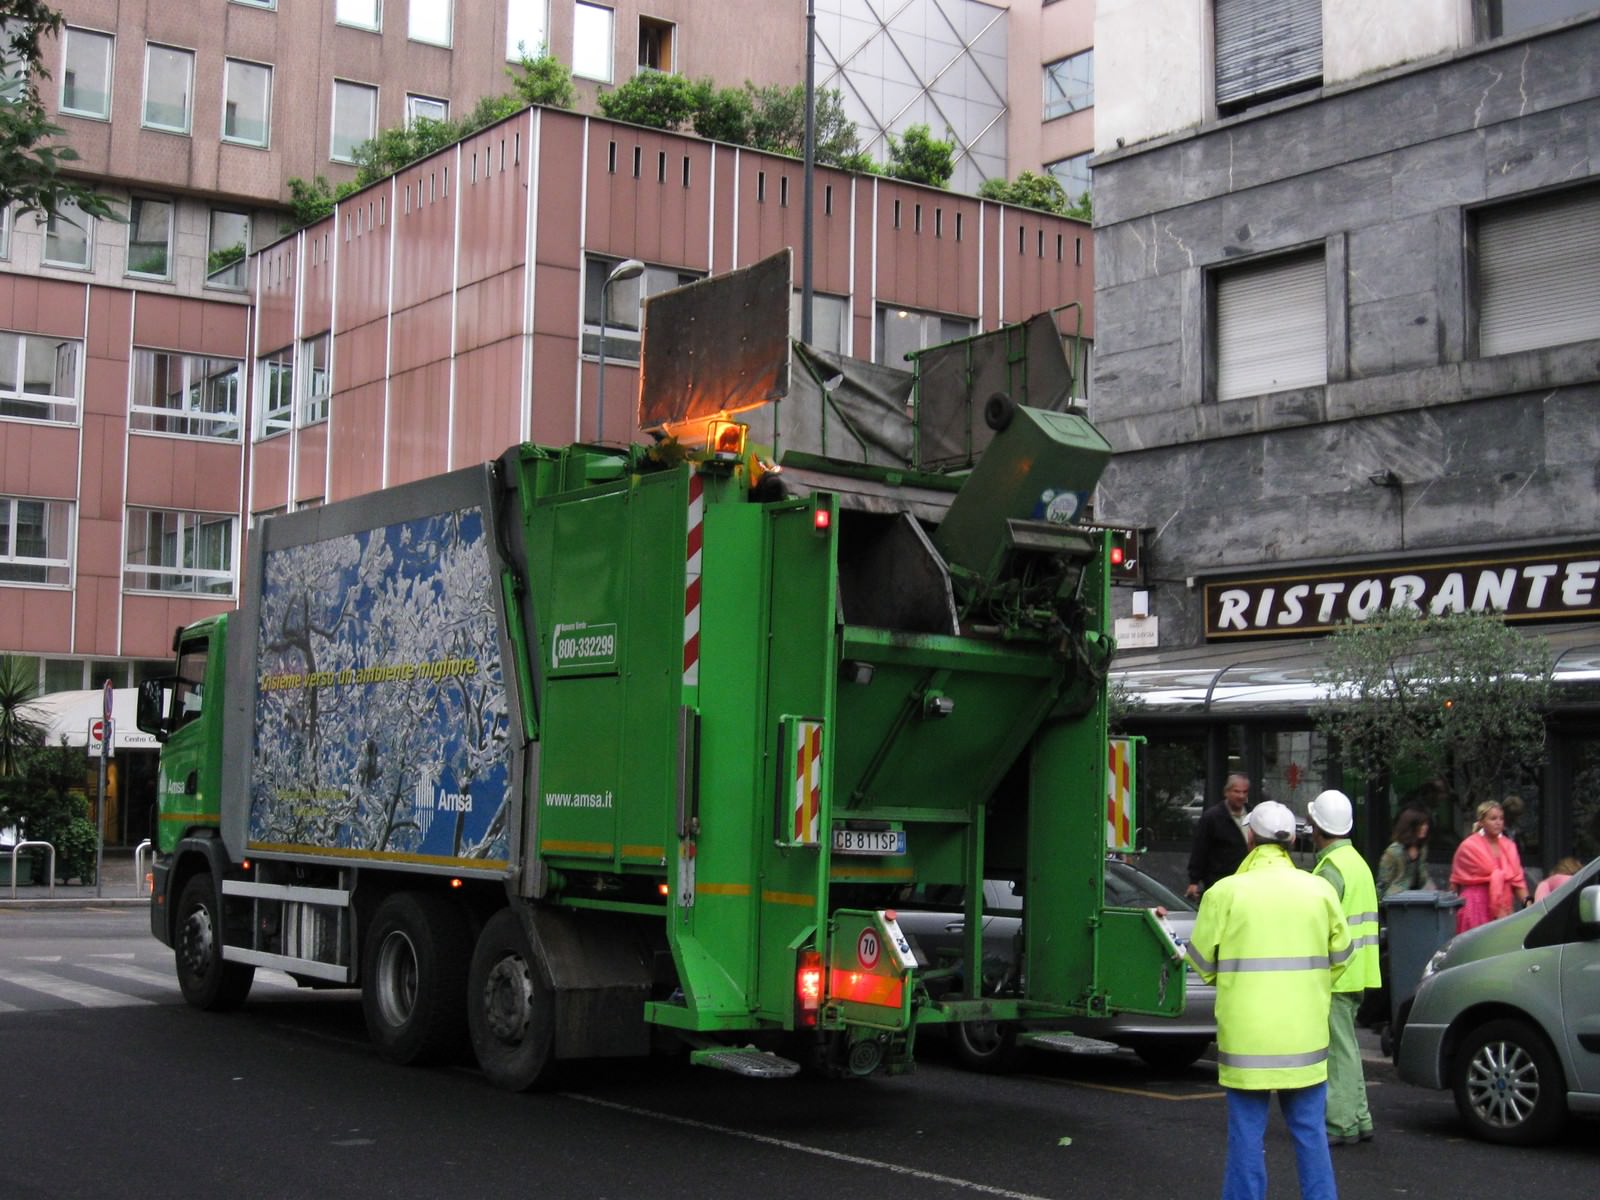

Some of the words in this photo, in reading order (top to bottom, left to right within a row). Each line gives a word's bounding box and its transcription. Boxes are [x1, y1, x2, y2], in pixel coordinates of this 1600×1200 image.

[1217, 561, 1600, 630] RISTORANTE
[558, 634, 614, 659] 800-332299
[303, 671, 334, 687] verso
[337, 669, 354, 685] un
[356, 663, 415, 683] ambiente
[437, 788, 473, 812] Amsa
[545, 790, 613, 808] www.amsa.it
[863, 938, 875, 956] 70
